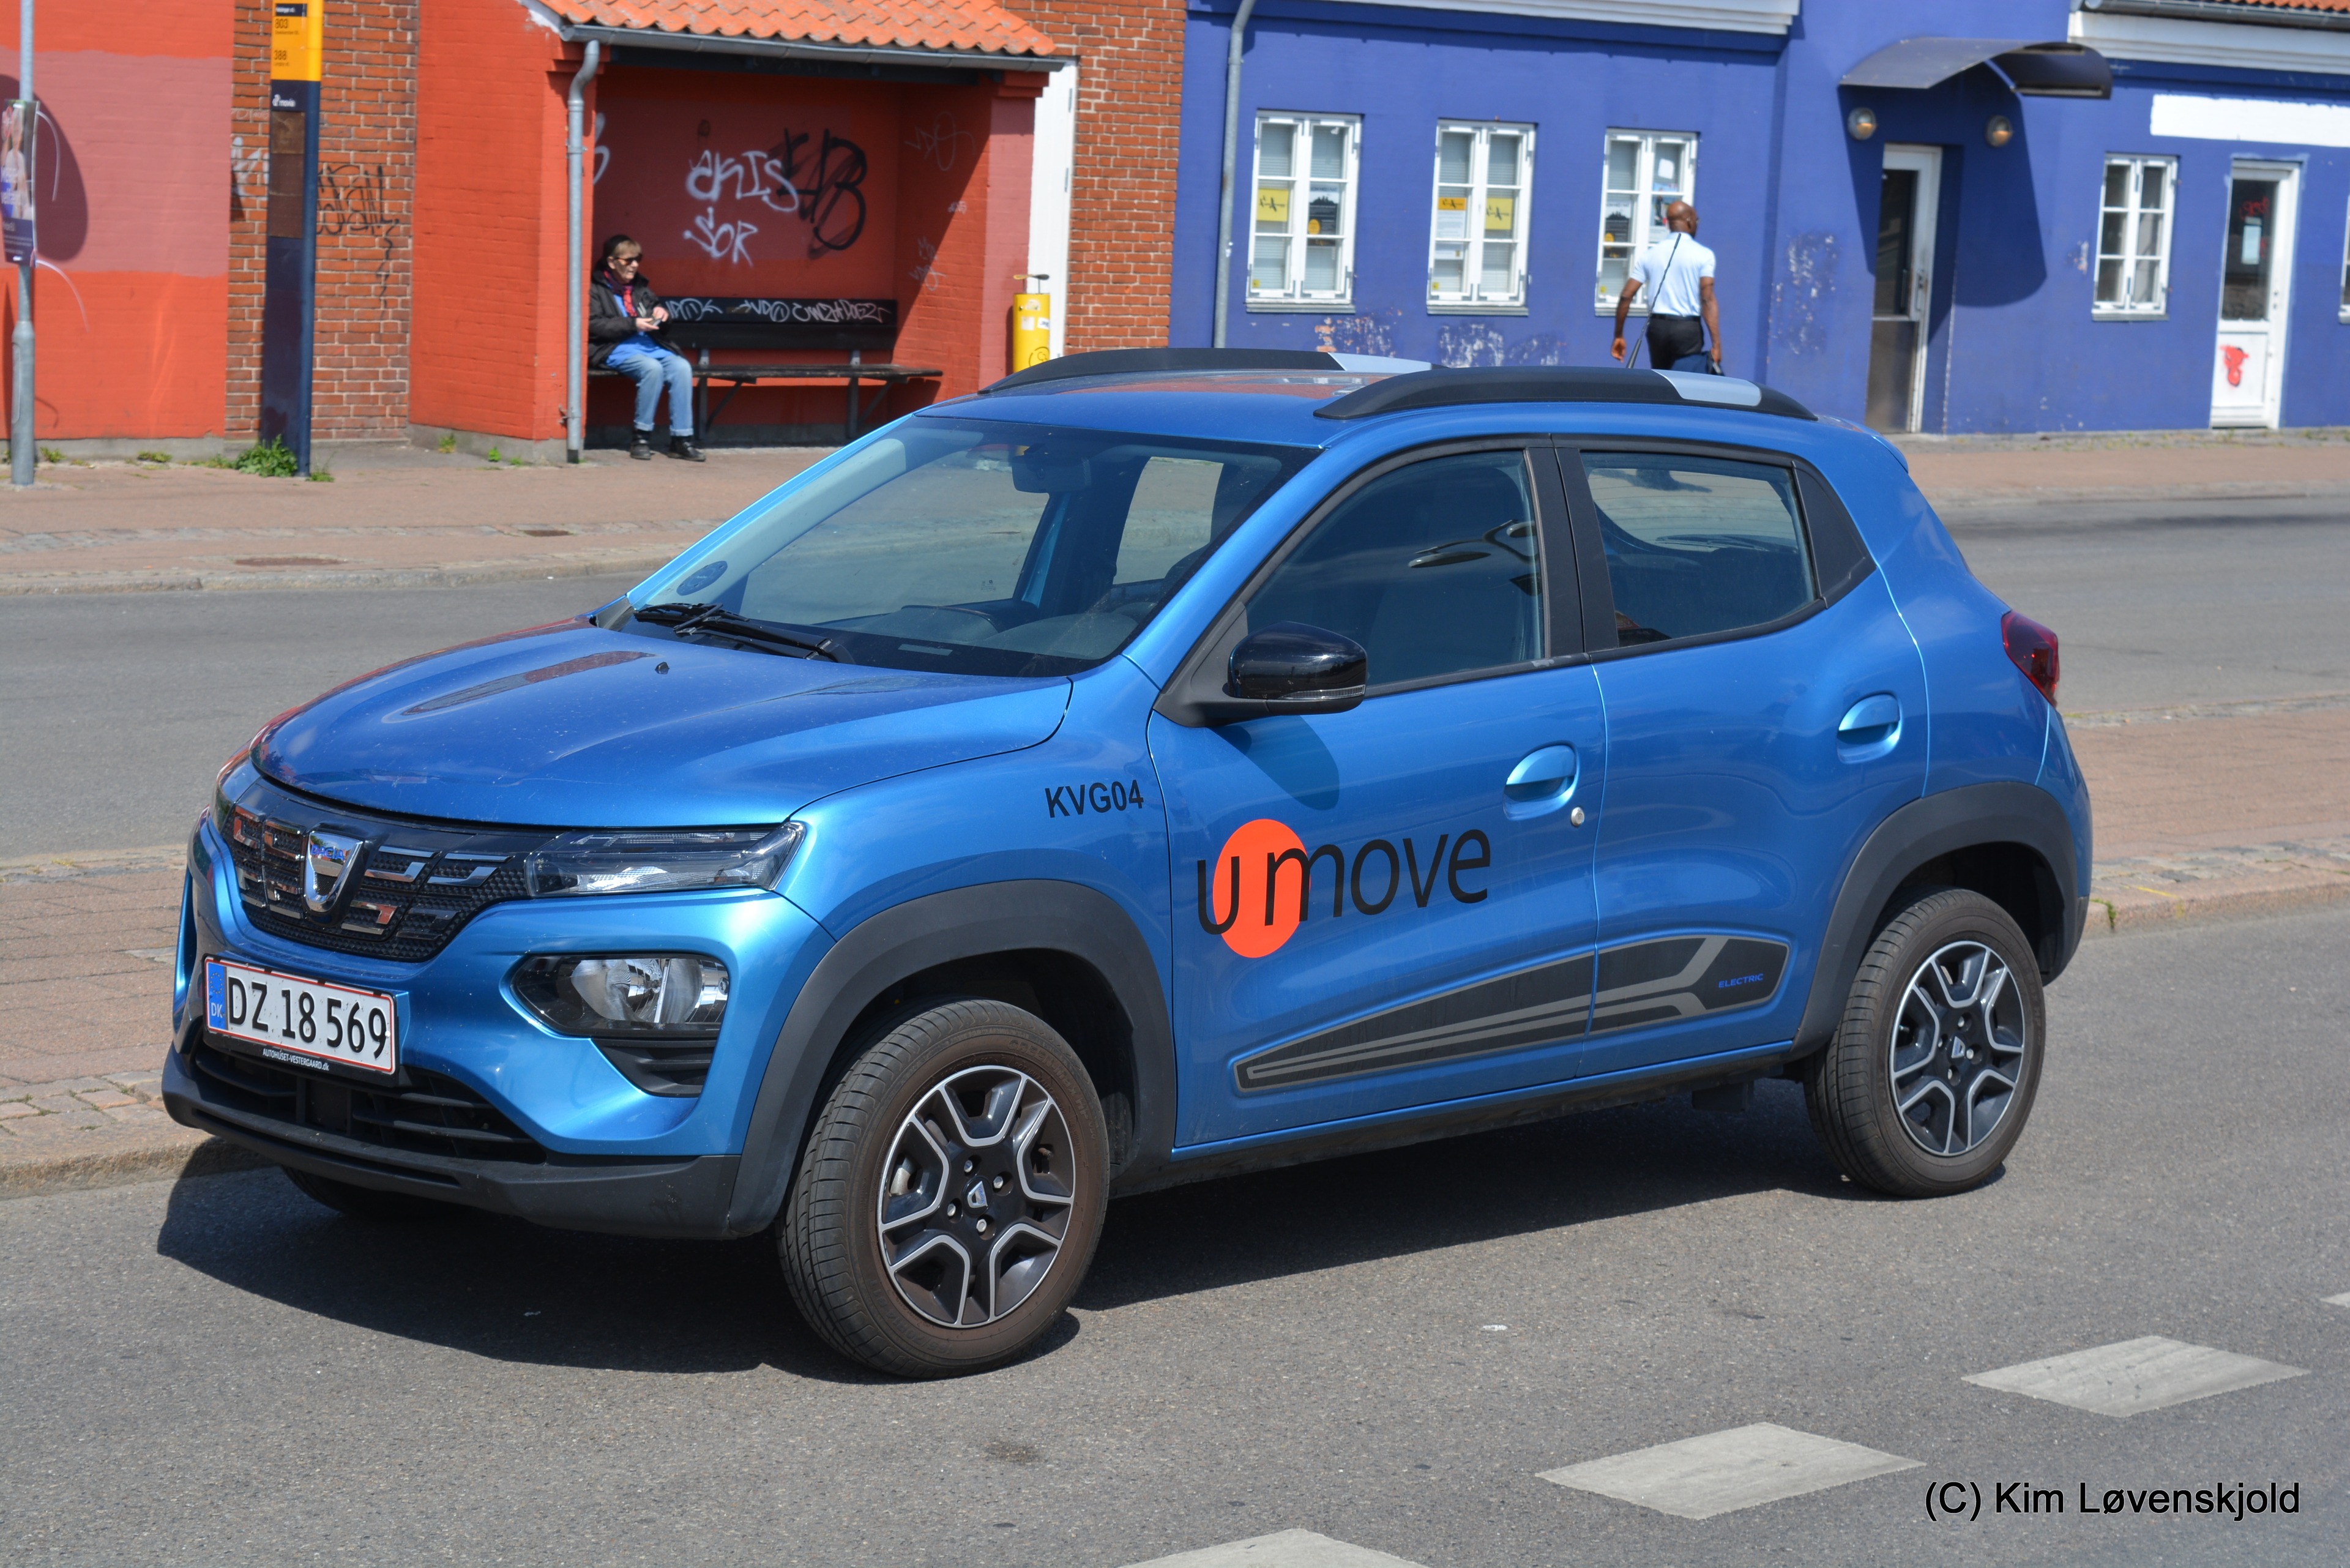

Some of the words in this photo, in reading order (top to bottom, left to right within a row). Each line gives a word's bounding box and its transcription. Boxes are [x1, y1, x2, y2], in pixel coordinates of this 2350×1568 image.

[1044, 779, 1144, 818] KVG04
[311, 844, 345, 861] DACIA
[1718, 973, 1764, 988] ELECTRIC
[211, 1002, 223, 1018] DK
[228, 976, 269, 1032] DZ
[281, 989, 316, 1043] 18
[326, 997, 387, 1060] 569
